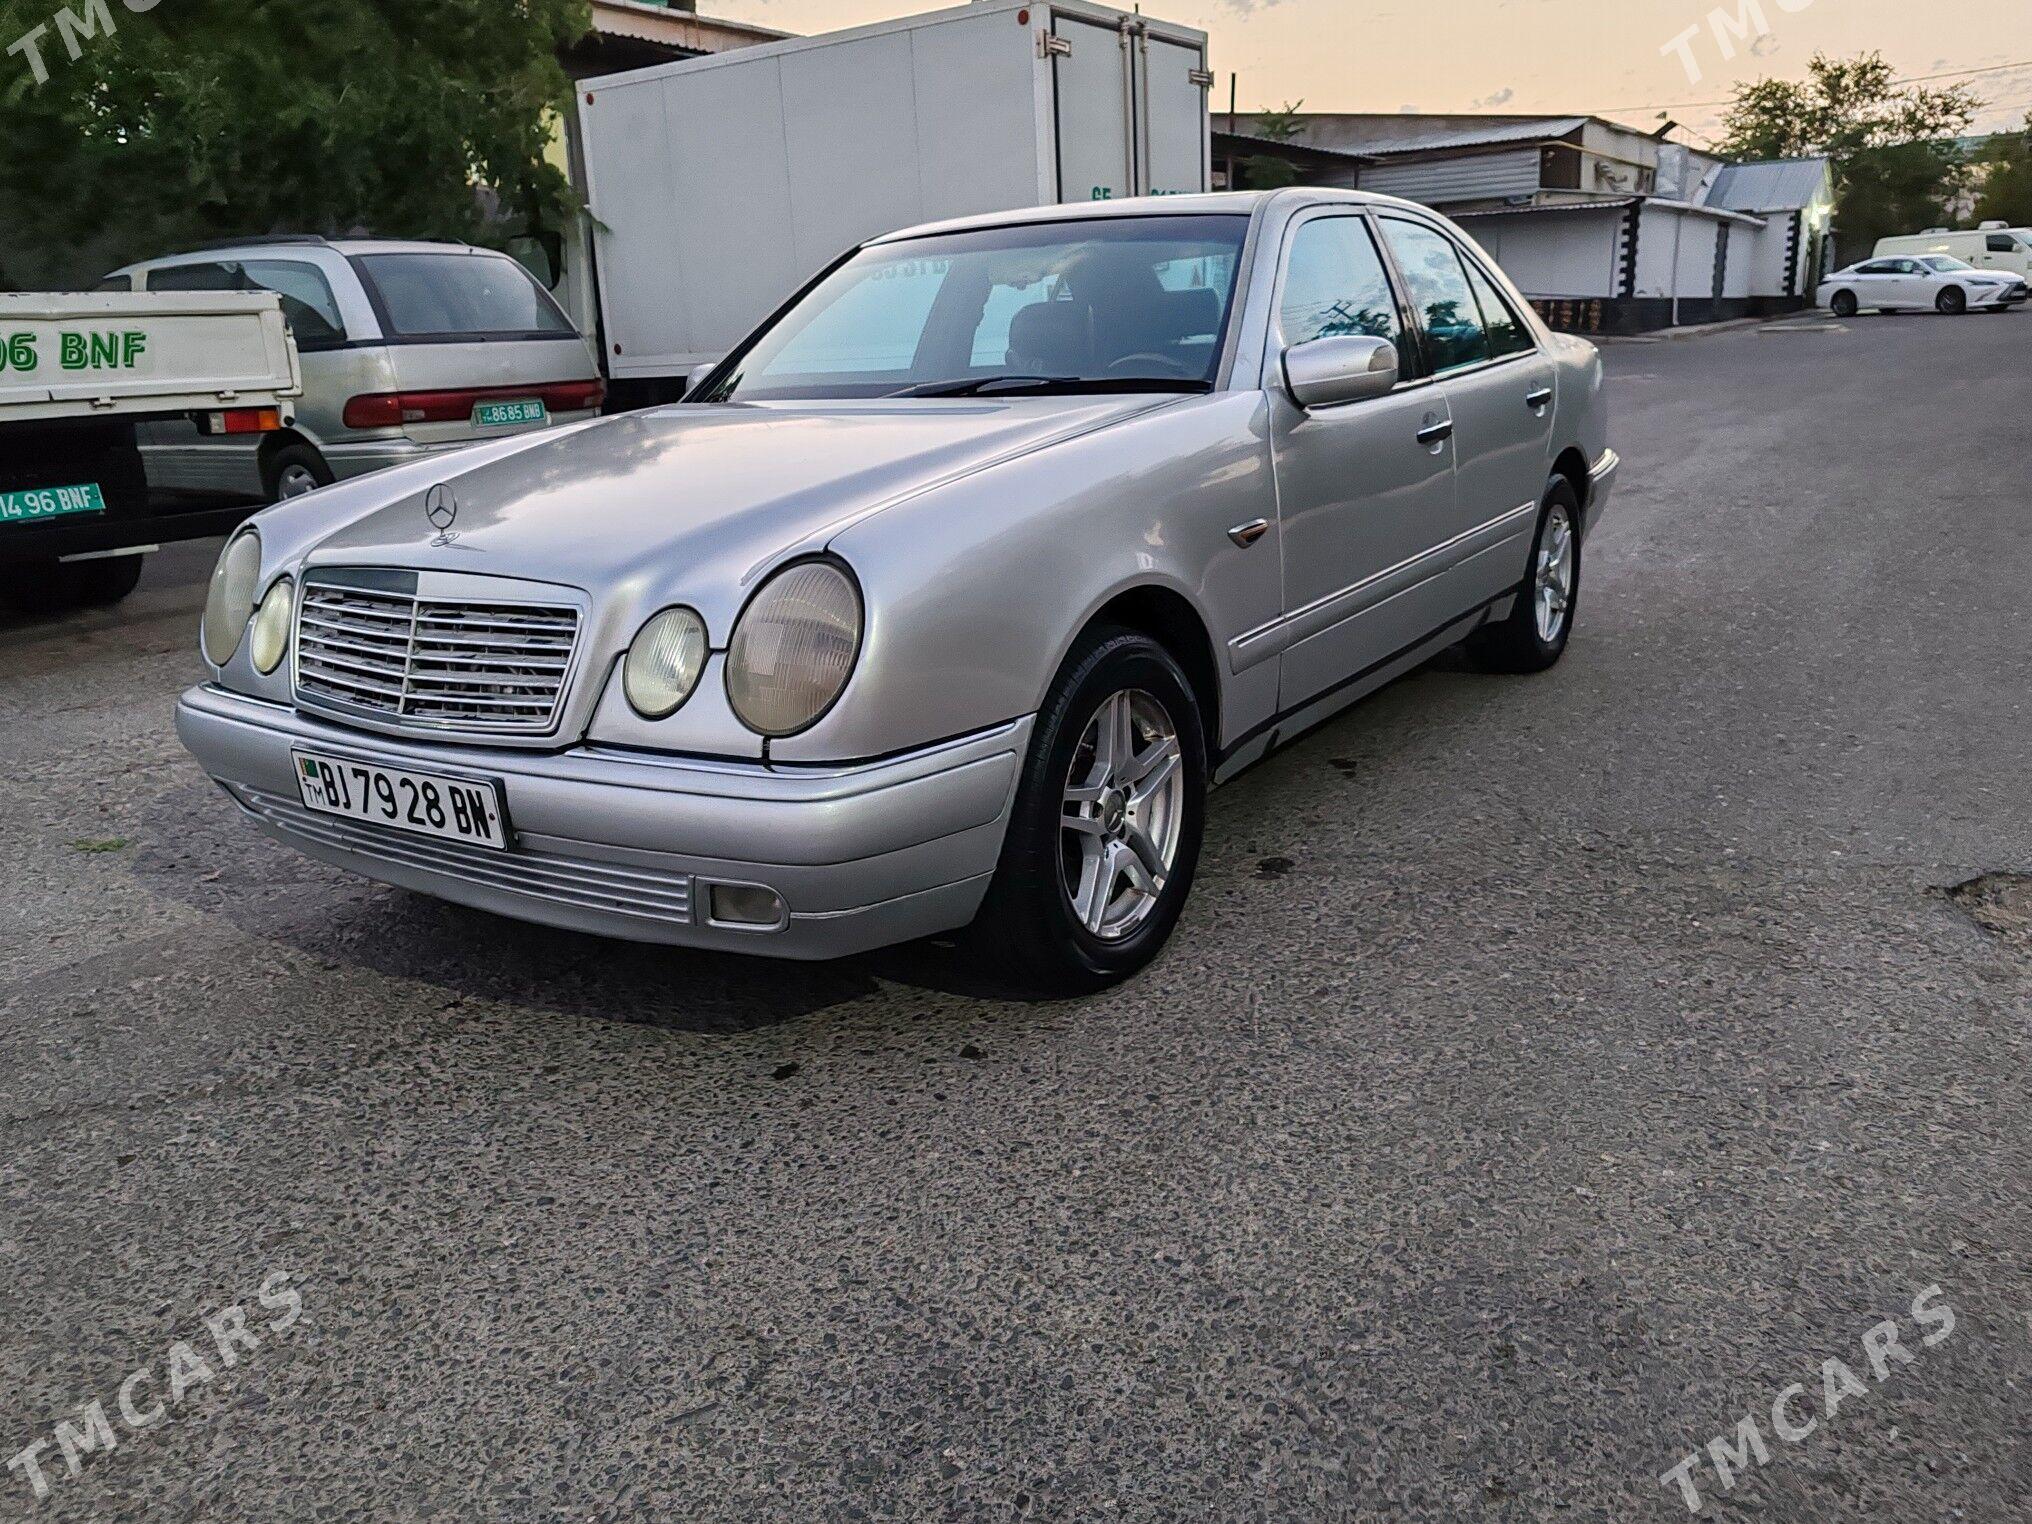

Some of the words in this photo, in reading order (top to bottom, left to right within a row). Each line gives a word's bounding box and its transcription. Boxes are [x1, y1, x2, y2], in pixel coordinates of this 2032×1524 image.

[0, 332, 38, 372] 6
[60, 332, 146, 369] BNF
[56, 487, 91, 510] BNF
[306, 783, 326, 805] TM
